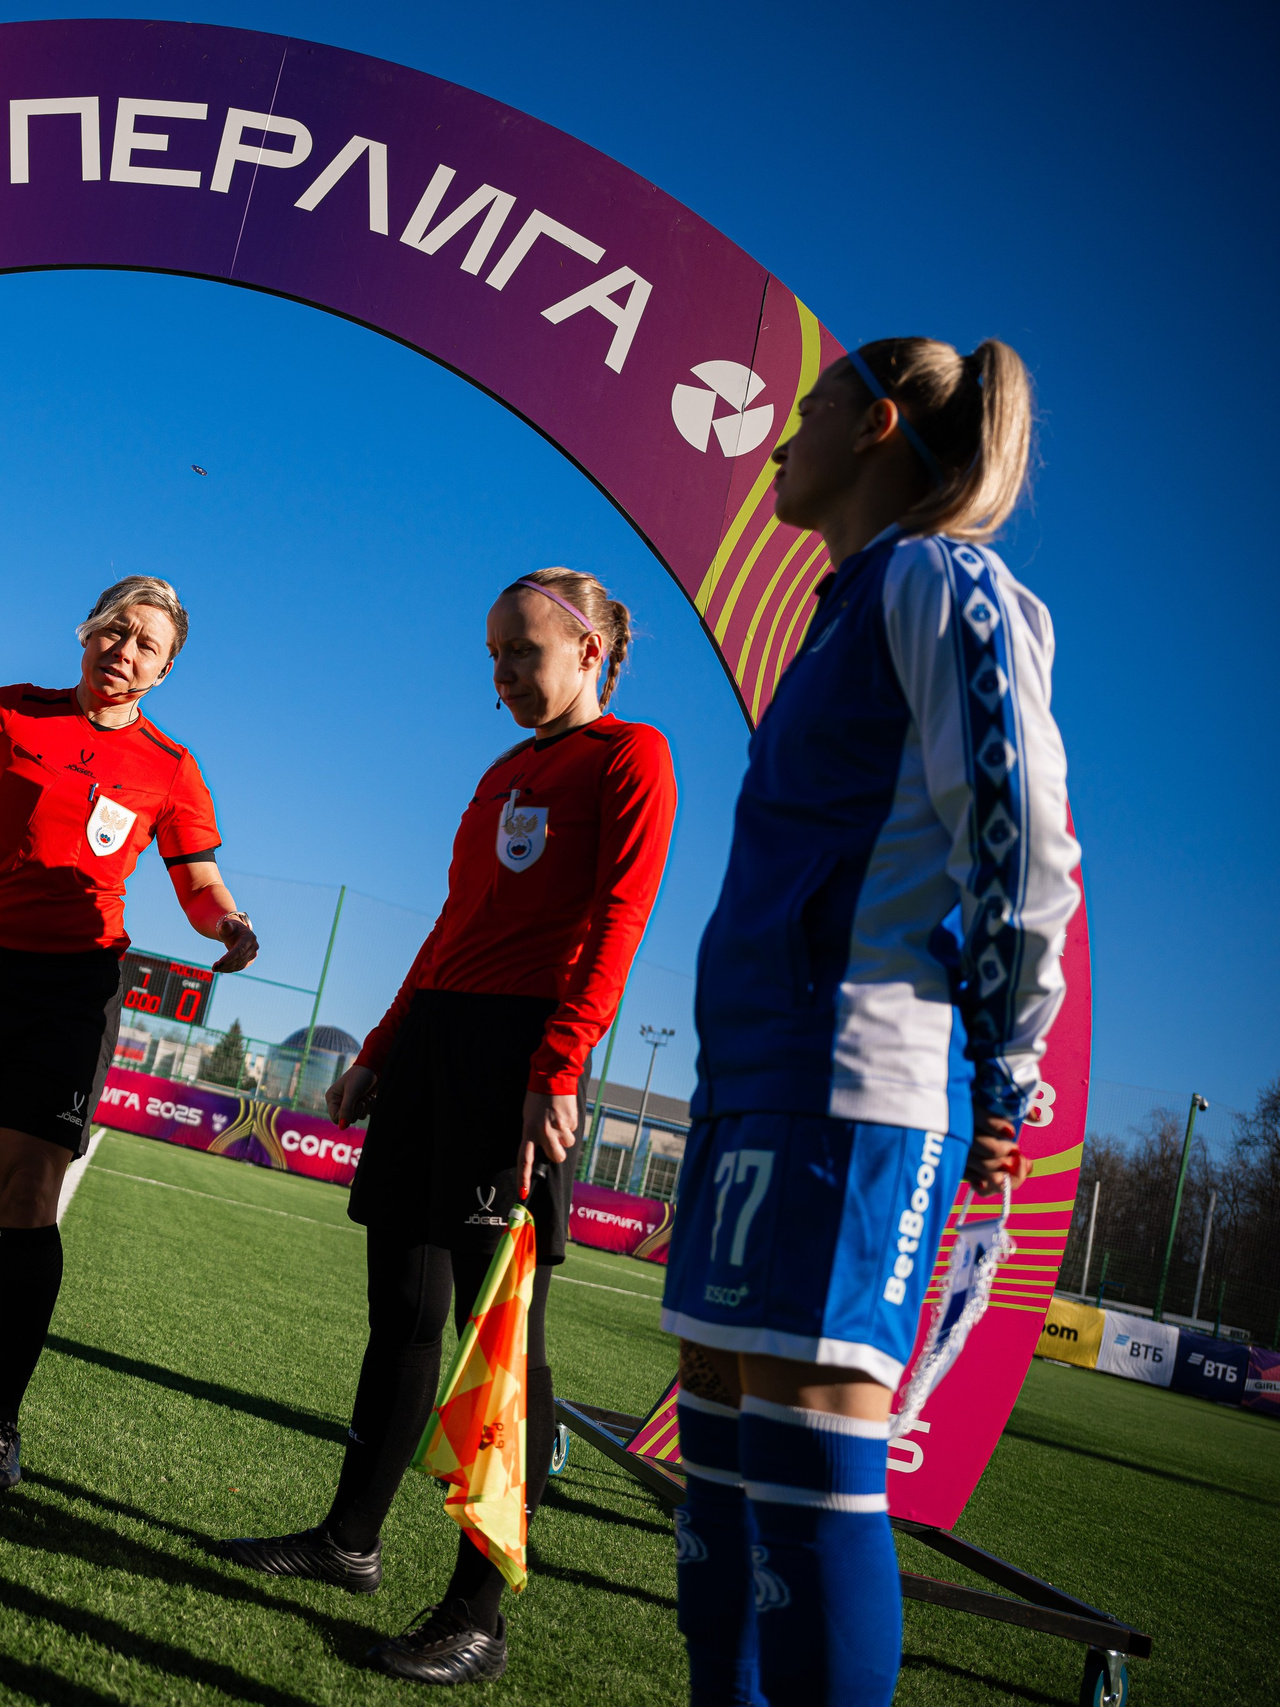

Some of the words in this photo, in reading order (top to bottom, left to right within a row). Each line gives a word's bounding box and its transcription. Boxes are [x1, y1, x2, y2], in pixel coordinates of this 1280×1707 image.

[63, 763, 96, 779] JÖGEL
[142, 973, 151, 989] 1
[174, 988, 202, 1022] 0
[56, 1111, 84, 1127] JÖGEL
[145, 1096, 205, 1127] 2025
[464, 1212, 509, 1226] JÖGEL
[577, 1206, 644, 1233] СУПЕРЛИГА
[711, 1148, 776, 1267] 77
[882, 1130, 946, 1307] BetBoom
[1129, 1341, 1164, 1364] ВТБ
[1203, 1359, 1238, 1383] ВТБ
